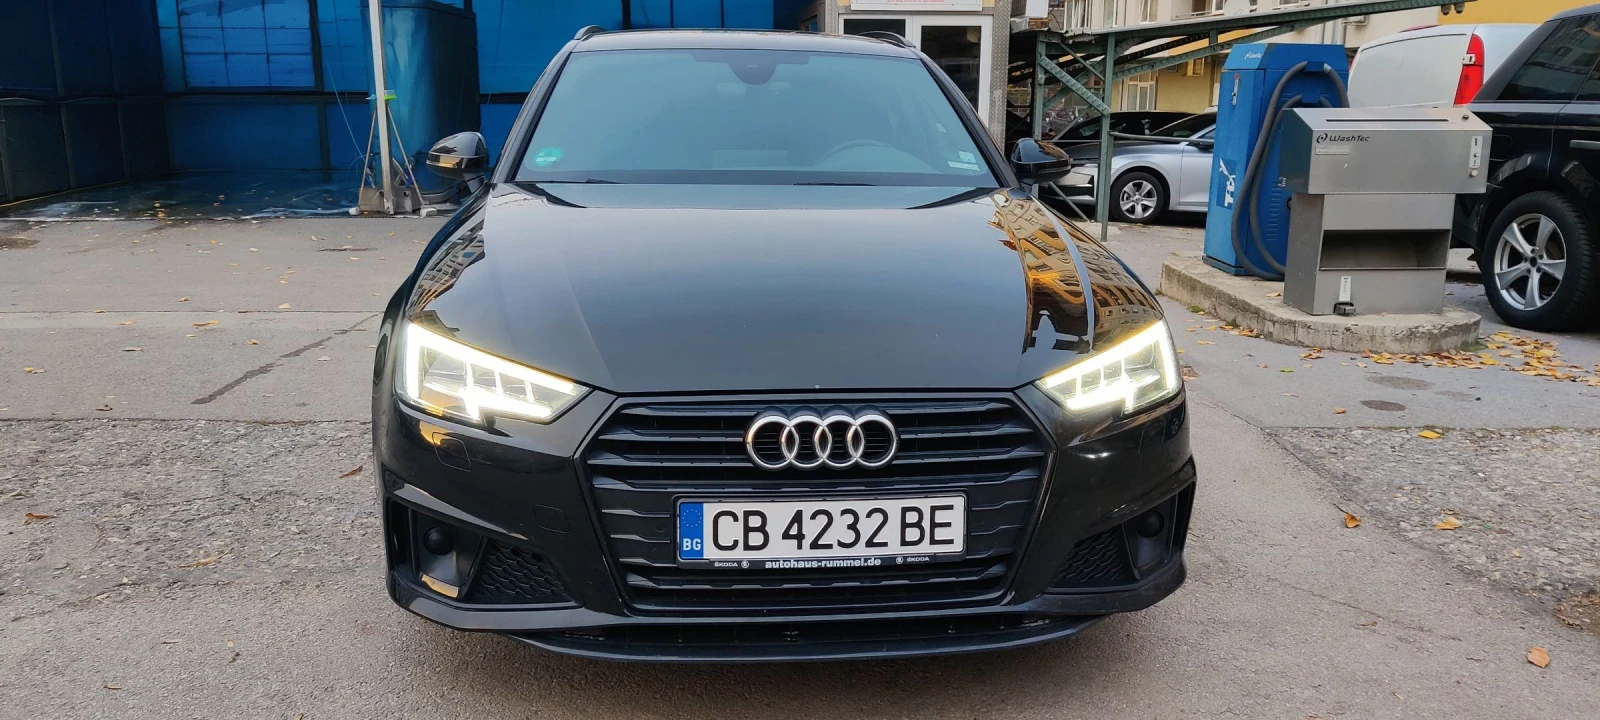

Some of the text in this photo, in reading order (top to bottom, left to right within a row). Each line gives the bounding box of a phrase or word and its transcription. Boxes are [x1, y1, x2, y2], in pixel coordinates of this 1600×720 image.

[1329, 134, 1370, 142] WashTec
[712, 504, 955, 551] CB 4232 BE
[682, 538, 701, 550] BG
[765, 557, 881, 568] autohaus-rummel.de
